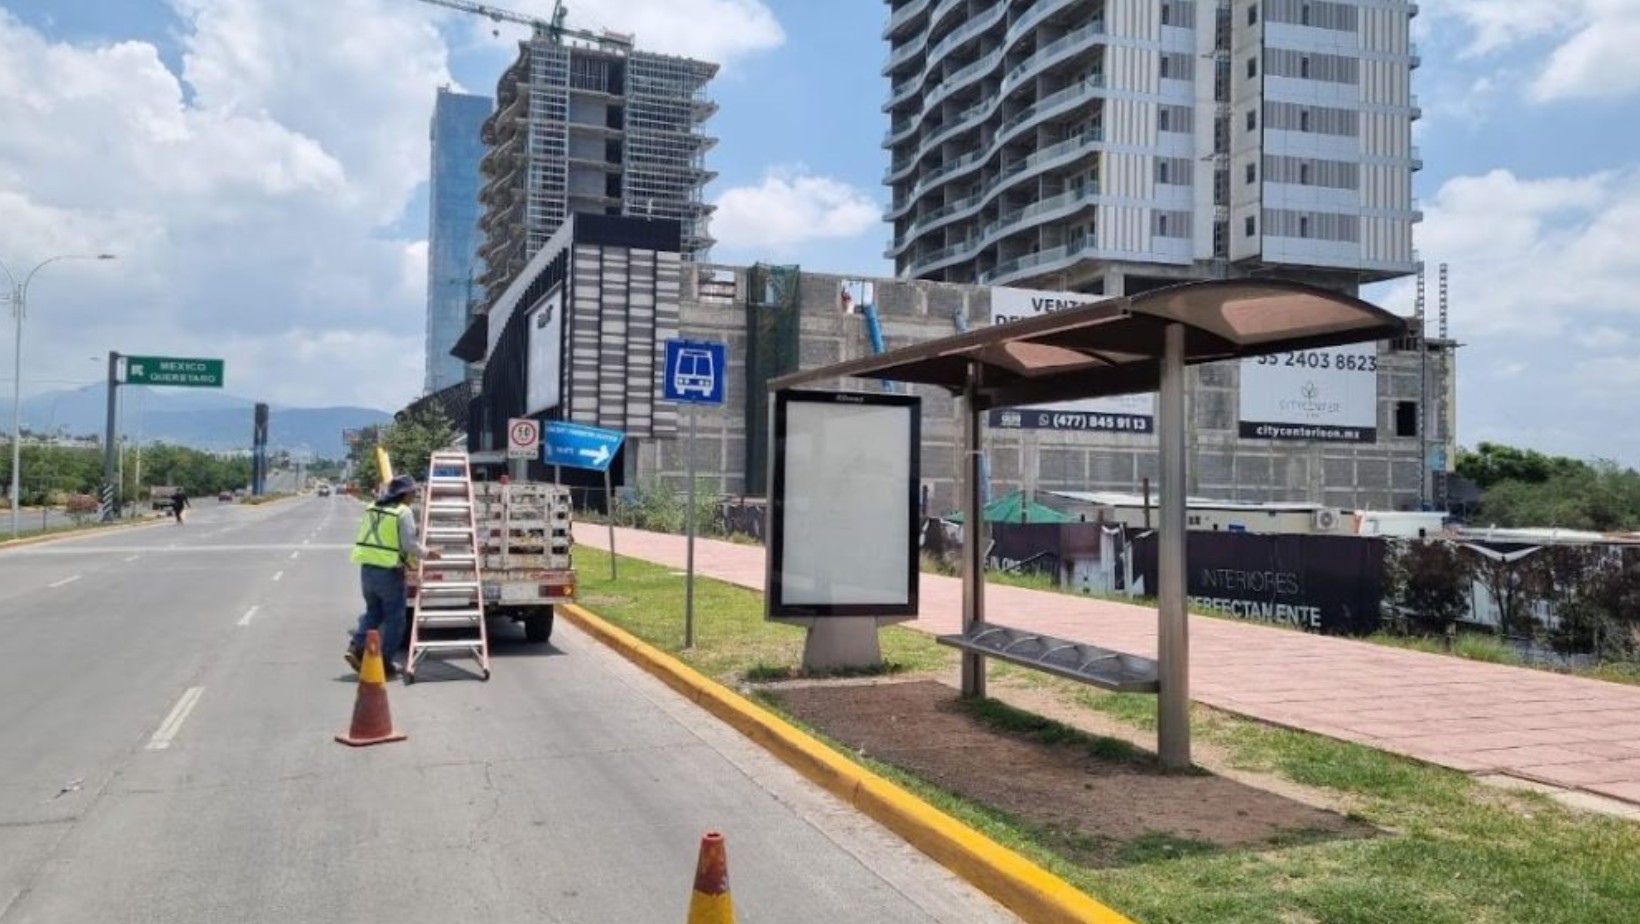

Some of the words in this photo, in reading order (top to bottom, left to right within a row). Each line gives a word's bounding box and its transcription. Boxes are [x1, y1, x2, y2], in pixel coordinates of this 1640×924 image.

[159, 361, 207, 372] MEXICO
[1285, 351, 1330, 369] 2403
[1335, 354, 1378, 371] 8623
[1052, 414, 1087, 429] (477)
[1089, 415, 1115, 429] 845
[1116, 417, 1130, 430] 91
[1133, 418, 1147, 430] 13
[1255, 424, 1361, 439] citycenterleon.mx
